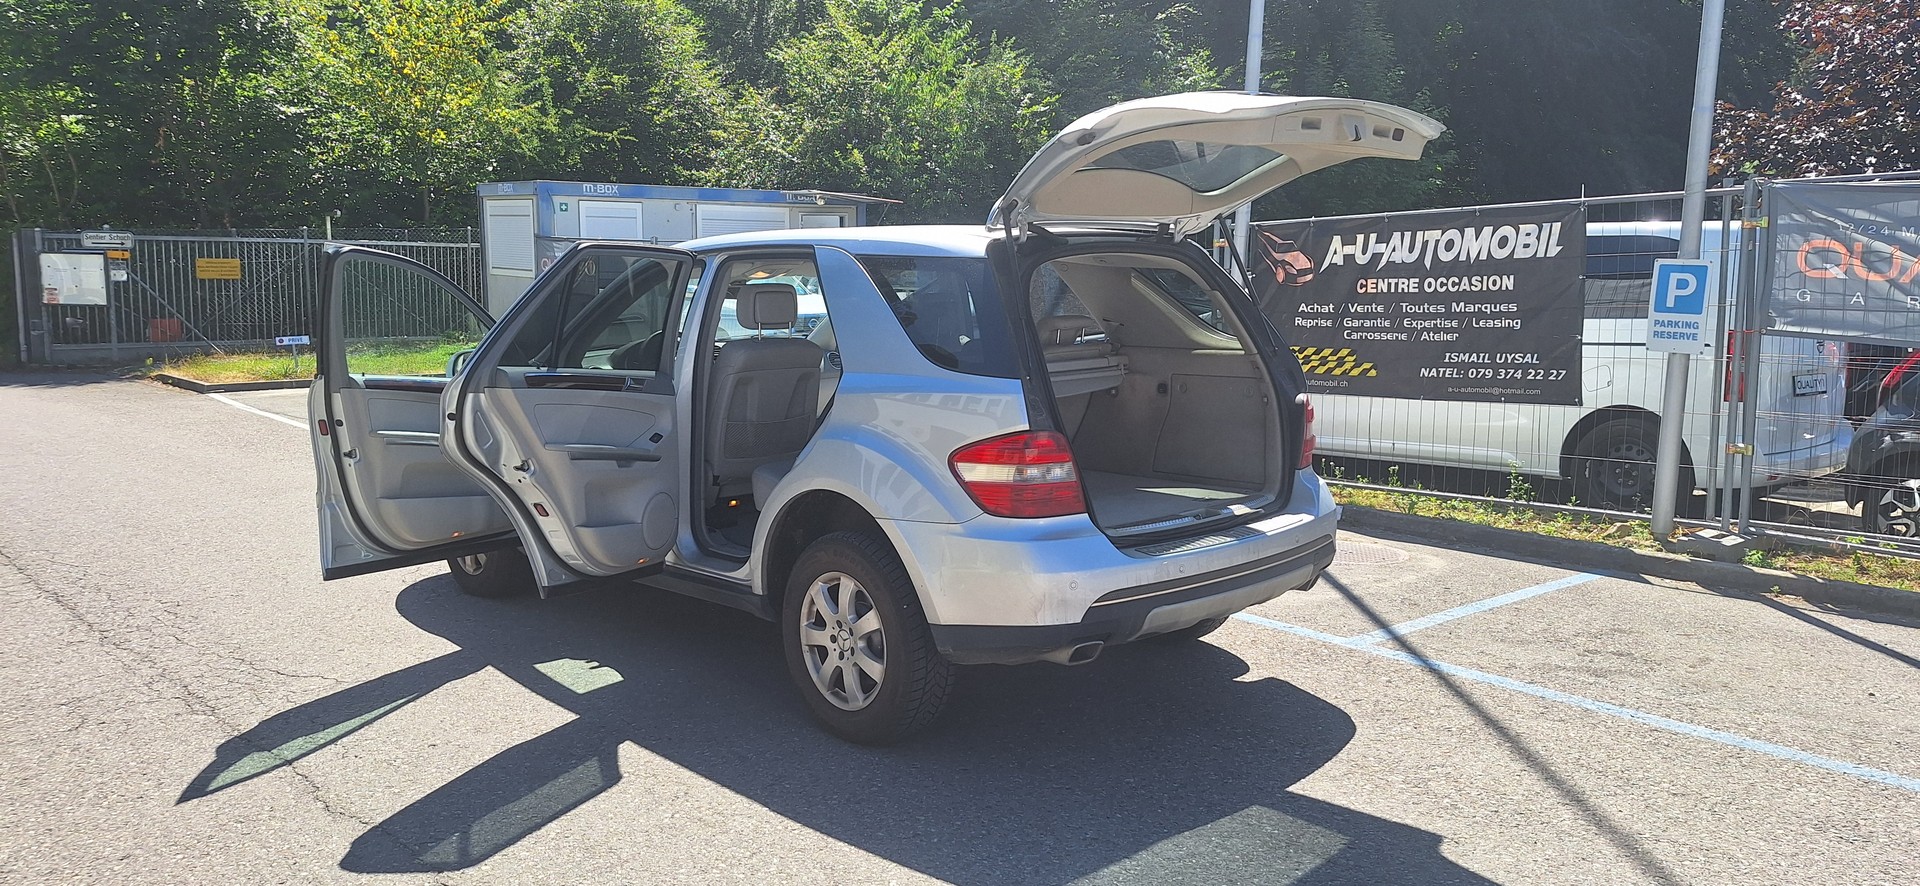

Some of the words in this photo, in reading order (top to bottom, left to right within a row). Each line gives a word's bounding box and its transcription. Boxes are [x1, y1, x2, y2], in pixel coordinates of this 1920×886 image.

[1319, 222, 1563, 273] A-U-AUTOMOBIL
[1356, 278, 1419, 294] CENTRE
[1424, 275, 1514, 293] OCCASION
[1666, 272, 1697, 308] P
[1298, 303, 1335, 313] Achat
[1348, 303, 1385, 313] Vente
[1400, 302, 1446, 313] Toutes
[1451, 302, 1518, 314] Marques
[1295, 317, 1333, 328] Reprise
[1343, 318, 1391, 328] Garantie
[1403, 318, 1459, 330] Expertise
[1472, 317, 1521, 330] Leasing
[1654, 319, 1699, 330] PARKING
[1343, 330, 1408, 340] Carrosserie
[1420, 331, 1459, 341] Atelier
[1653, 331, 1698, 341] RESERVE
[1443, 352, 1492, 364] ISMAIL
[1496, 353, 1540, 364] UYSAL
[1419, 368, 1464, 378] NATEL:
[1468, 368, 1493, 379] 079
[1496, 369, 1522, 380] 374
[1526, 369, 1544, 381] 22
[1548, 370, 1567, 381] 27
[1305, 379, 1349, 387] utomobil.ch
[1447, 386, 1541, 395] a-u-automobil@hotmail.com
